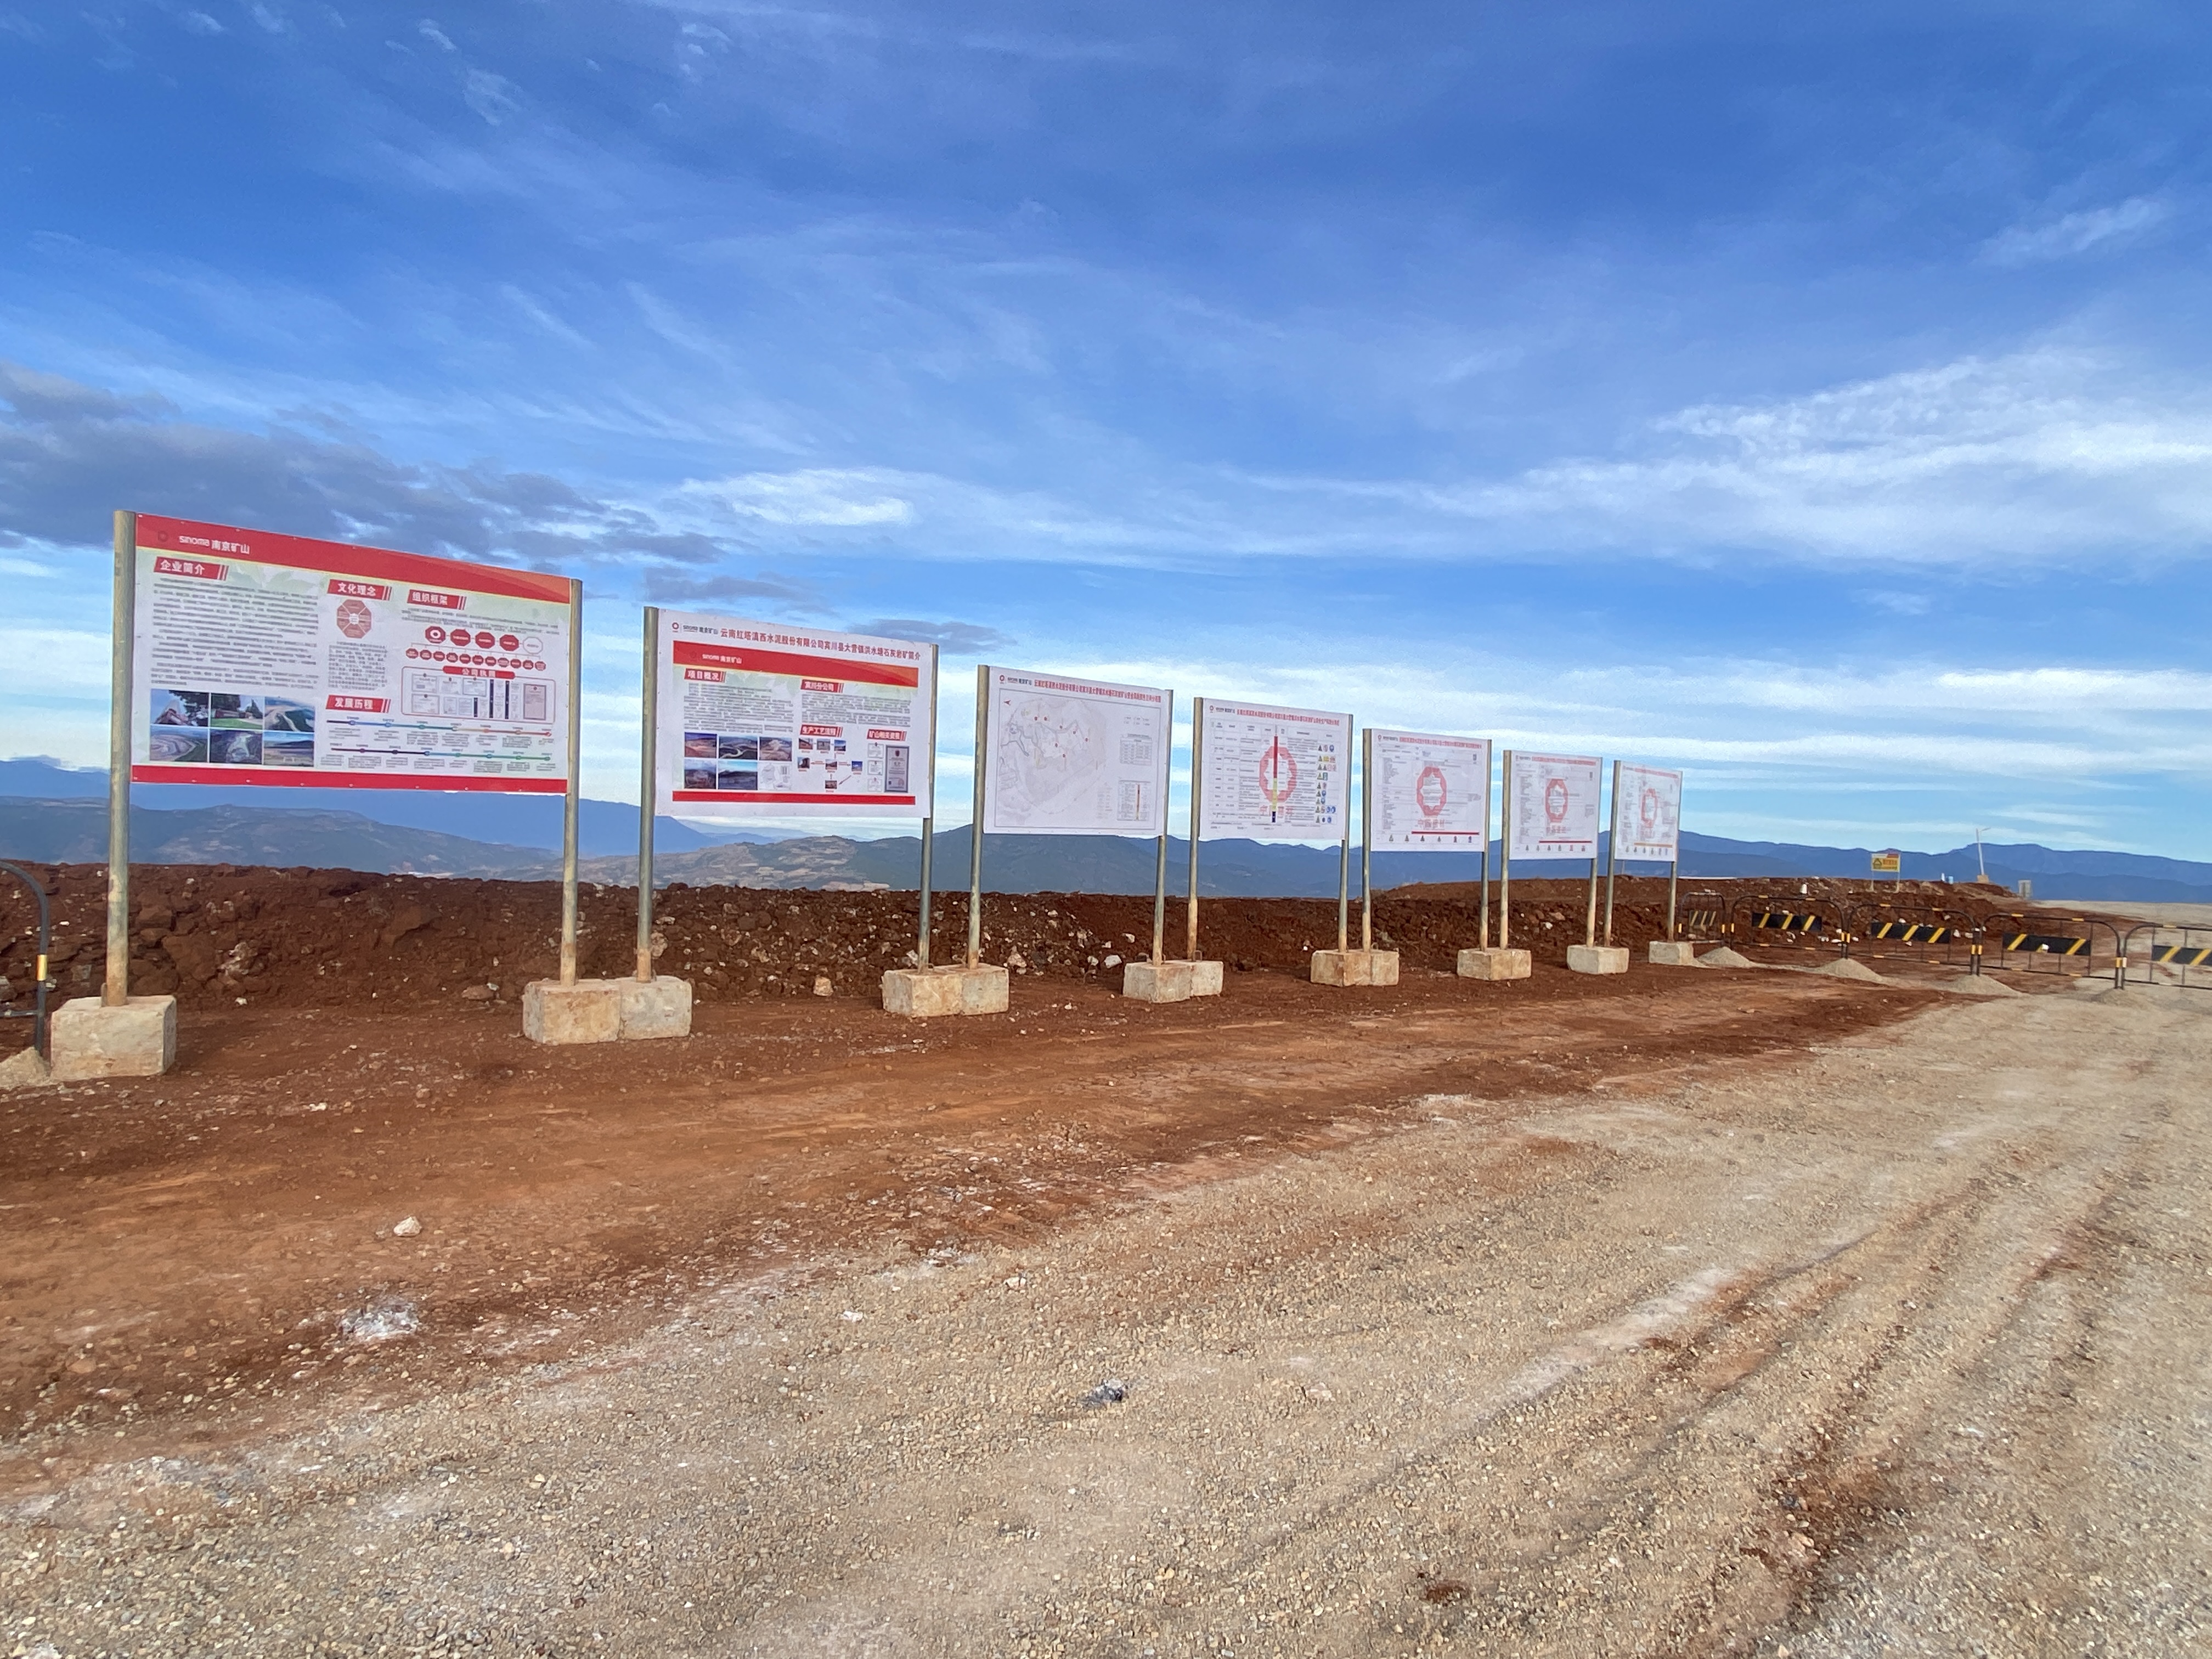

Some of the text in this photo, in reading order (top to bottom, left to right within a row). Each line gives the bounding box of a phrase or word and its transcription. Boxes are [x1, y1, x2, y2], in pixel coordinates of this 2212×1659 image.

[179, 535, 250, 554] sinoma 南京矿山
[160, 559, 205, 575] 企业简介
[337, 582, 376, 596] 文化理念
[412, 591, 447, 606] 组织框架
[334, 697, 374, 709] 发展历程
